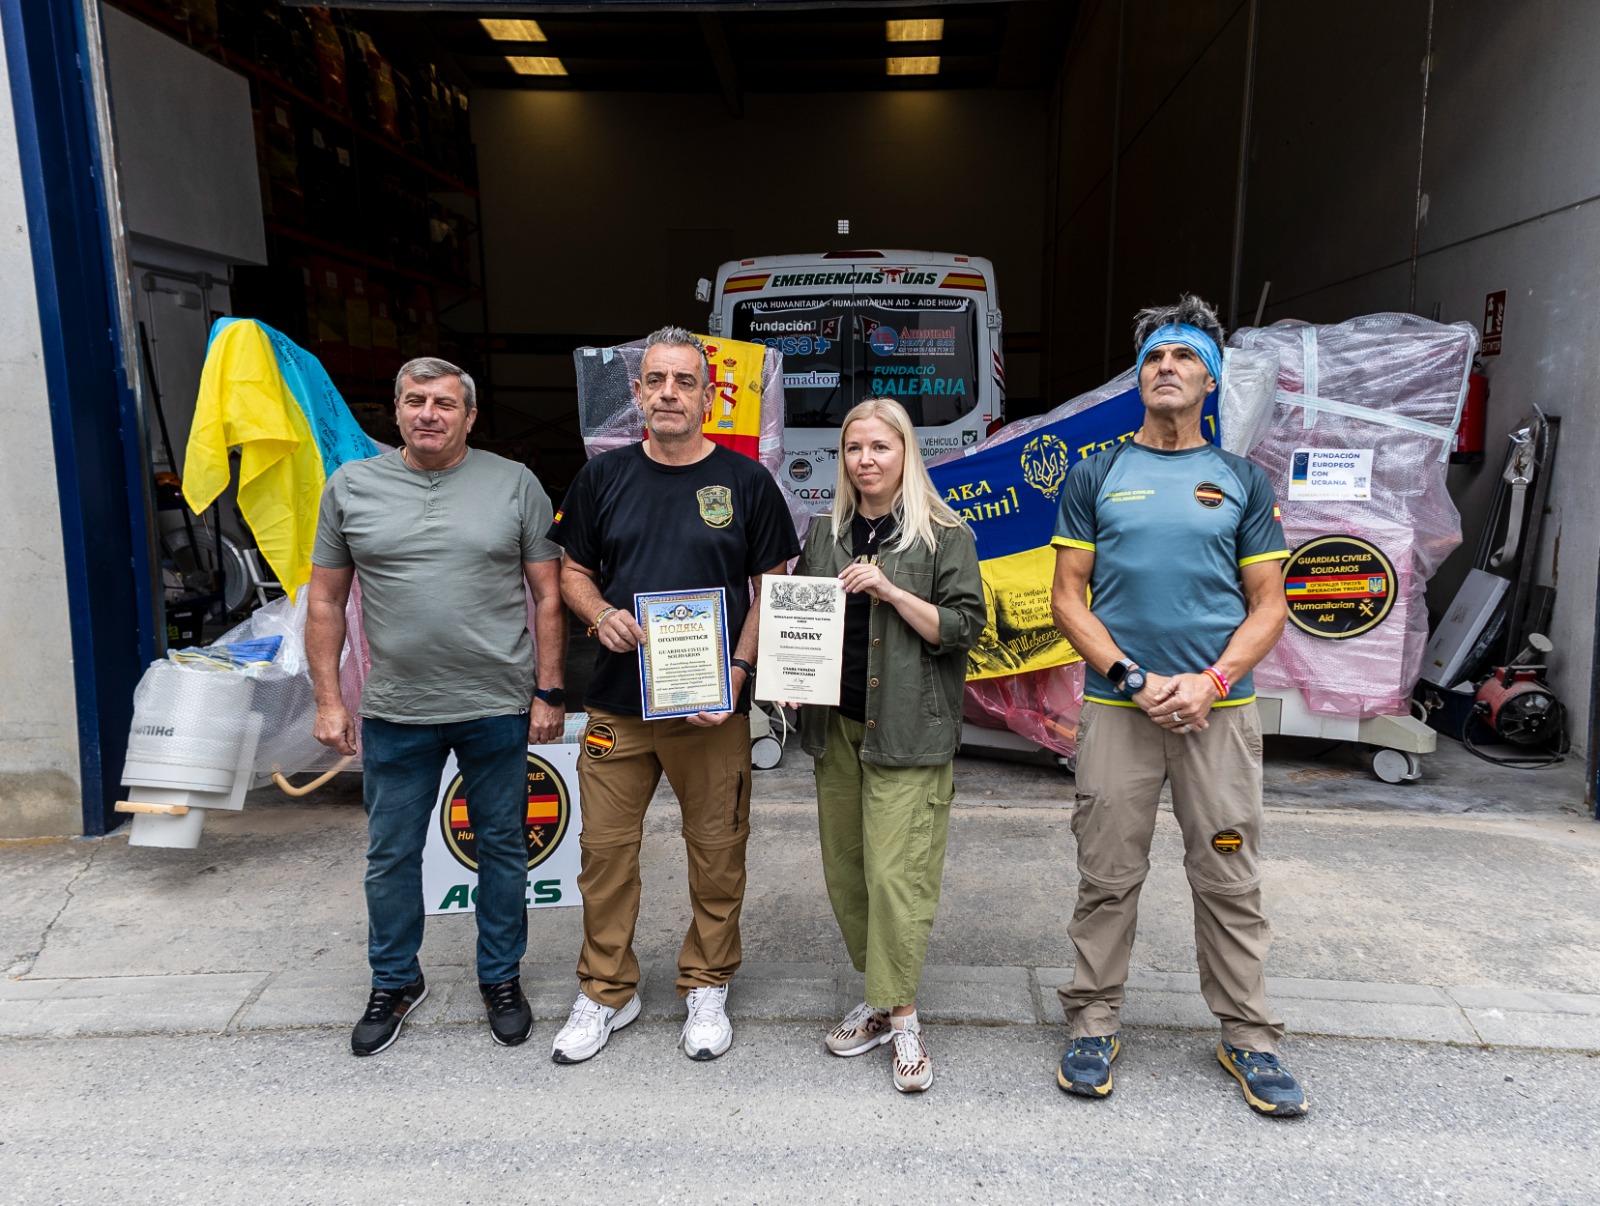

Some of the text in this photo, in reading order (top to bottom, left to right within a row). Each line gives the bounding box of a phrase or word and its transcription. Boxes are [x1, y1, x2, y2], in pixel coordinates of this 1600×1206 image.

[771, 272, 937, 287] EMERGENCIAS UAS
[741, 301, 768, 310] AYUDA
[770, 300, 825, 308] HUMANITARIA
[833, 299, 893, 308] HUMANITARIAN
[896, 299, 909, 307] AID
[918, 299, 936, 307] AIDE
[750, 320, 811, 331] fundación
[874, 364, 936, 375] FUNDACIÓ
[783, 370, 839, 385] rmadron
[873, 378, 966, 395] BALEARIA
[925, 436, 959, 446] VEHÍCULO
[944, 480, 992, 503] АВА
[1298, 553, 1372, 565] GUARDIAS CIVILES
[1310, 565, 1359, 575] SOLIDARIOS
[1293, 601, 1355, 611] Humanitarian
[1318, 613, 1335, 623] Aid
[660, 622, 705, 634] ПОДЯКА
[780, 630, 822, 641] ПОДЯКУ
